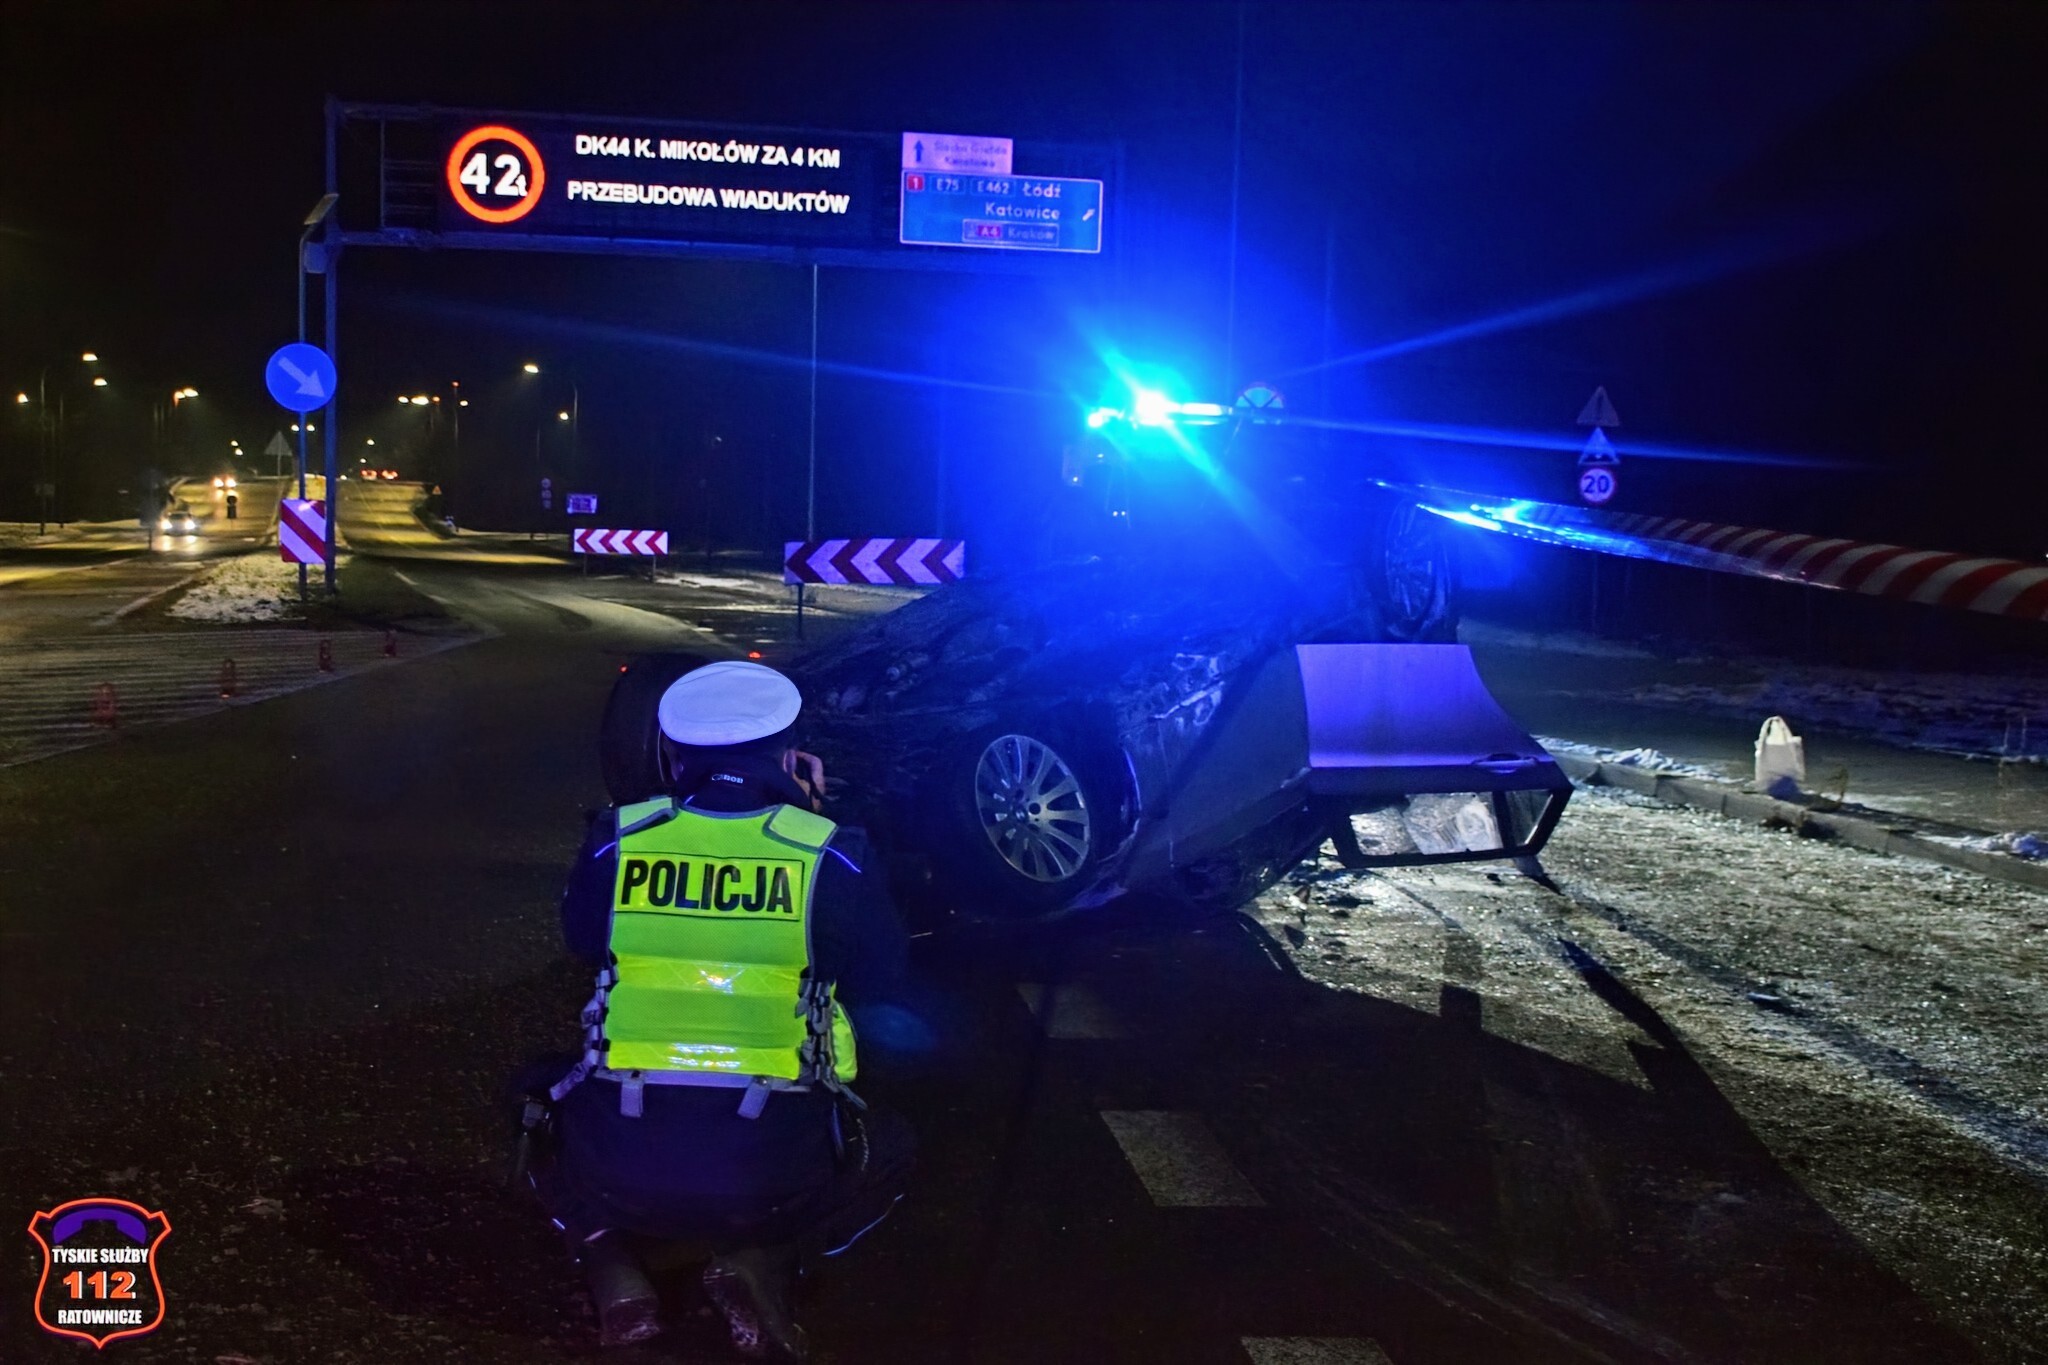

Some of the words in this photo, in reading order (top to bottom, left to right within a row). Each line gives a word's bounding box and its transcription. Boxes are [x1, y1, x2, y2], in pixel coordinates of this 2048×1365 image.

[576, 135, 630, 157] DK44
[634, 138, 656, 158] K.
[660, 140, 760, 164] MIKOŁÓW
[761, 145, 789, 166] ZA
[790, 147, 804, 166] 4
[808, 147, 840, 168] KM
[567, 180, 718, 207] PRZEBUDOWA
[720, 189, 850, 214] WIADUKTÓW
[1022, 181, 1061, 198] Łódź
[985, 202, 1060, 220] Katowice
[1583, 475, 1609, 494] 20
[620, 858, 794, 914] POLICJA
